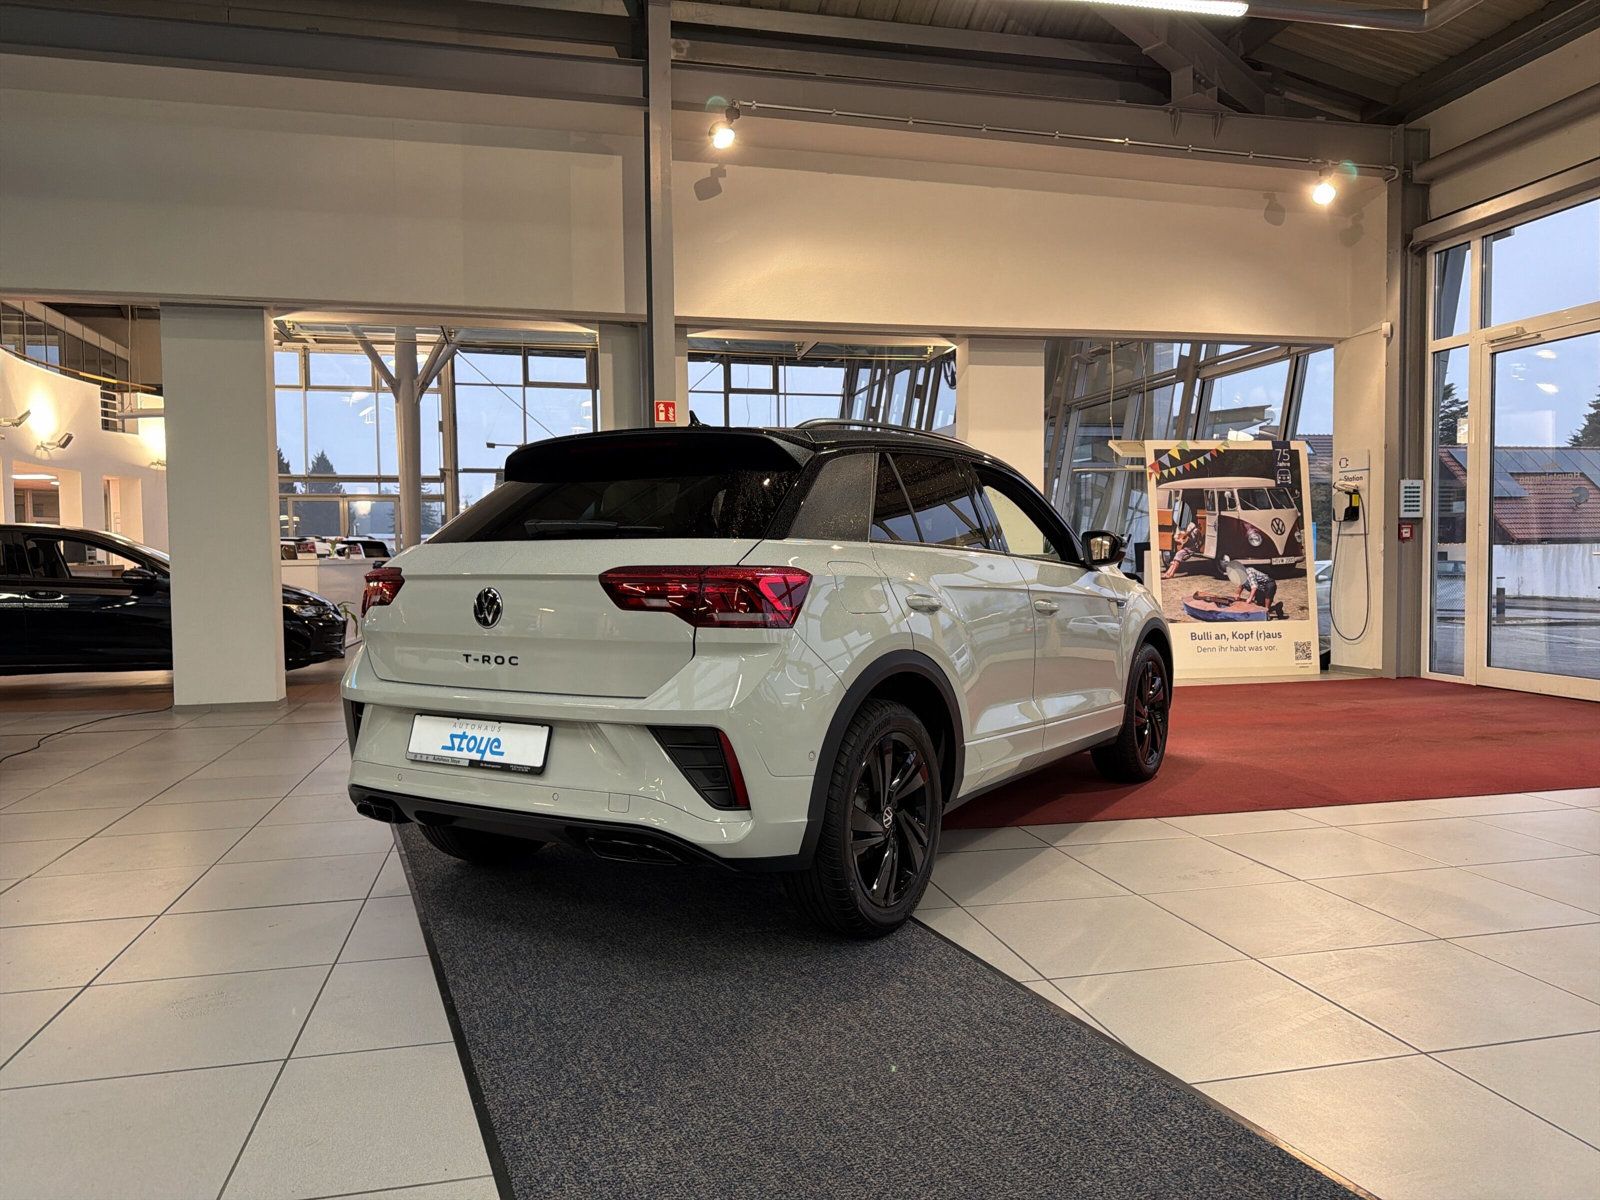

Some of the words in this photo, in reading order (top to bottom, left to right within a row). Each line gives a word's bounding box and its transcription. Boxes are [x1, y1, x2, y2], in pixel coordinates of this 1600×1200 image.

[1274, 448, 1290, 461] 75
[1190, 631, 1212, 641] Bulli
[1231, 631, 1255, 641] Kopf
[1256, 631, 1282, 641] (r)aus
[1196, 645, 1216, 653] Denn
[1218, 645, 1229, 653] ihr
[463, 653, 519, 666] T-ROC
[452, 722, 502, 733] AUTOHAUS
